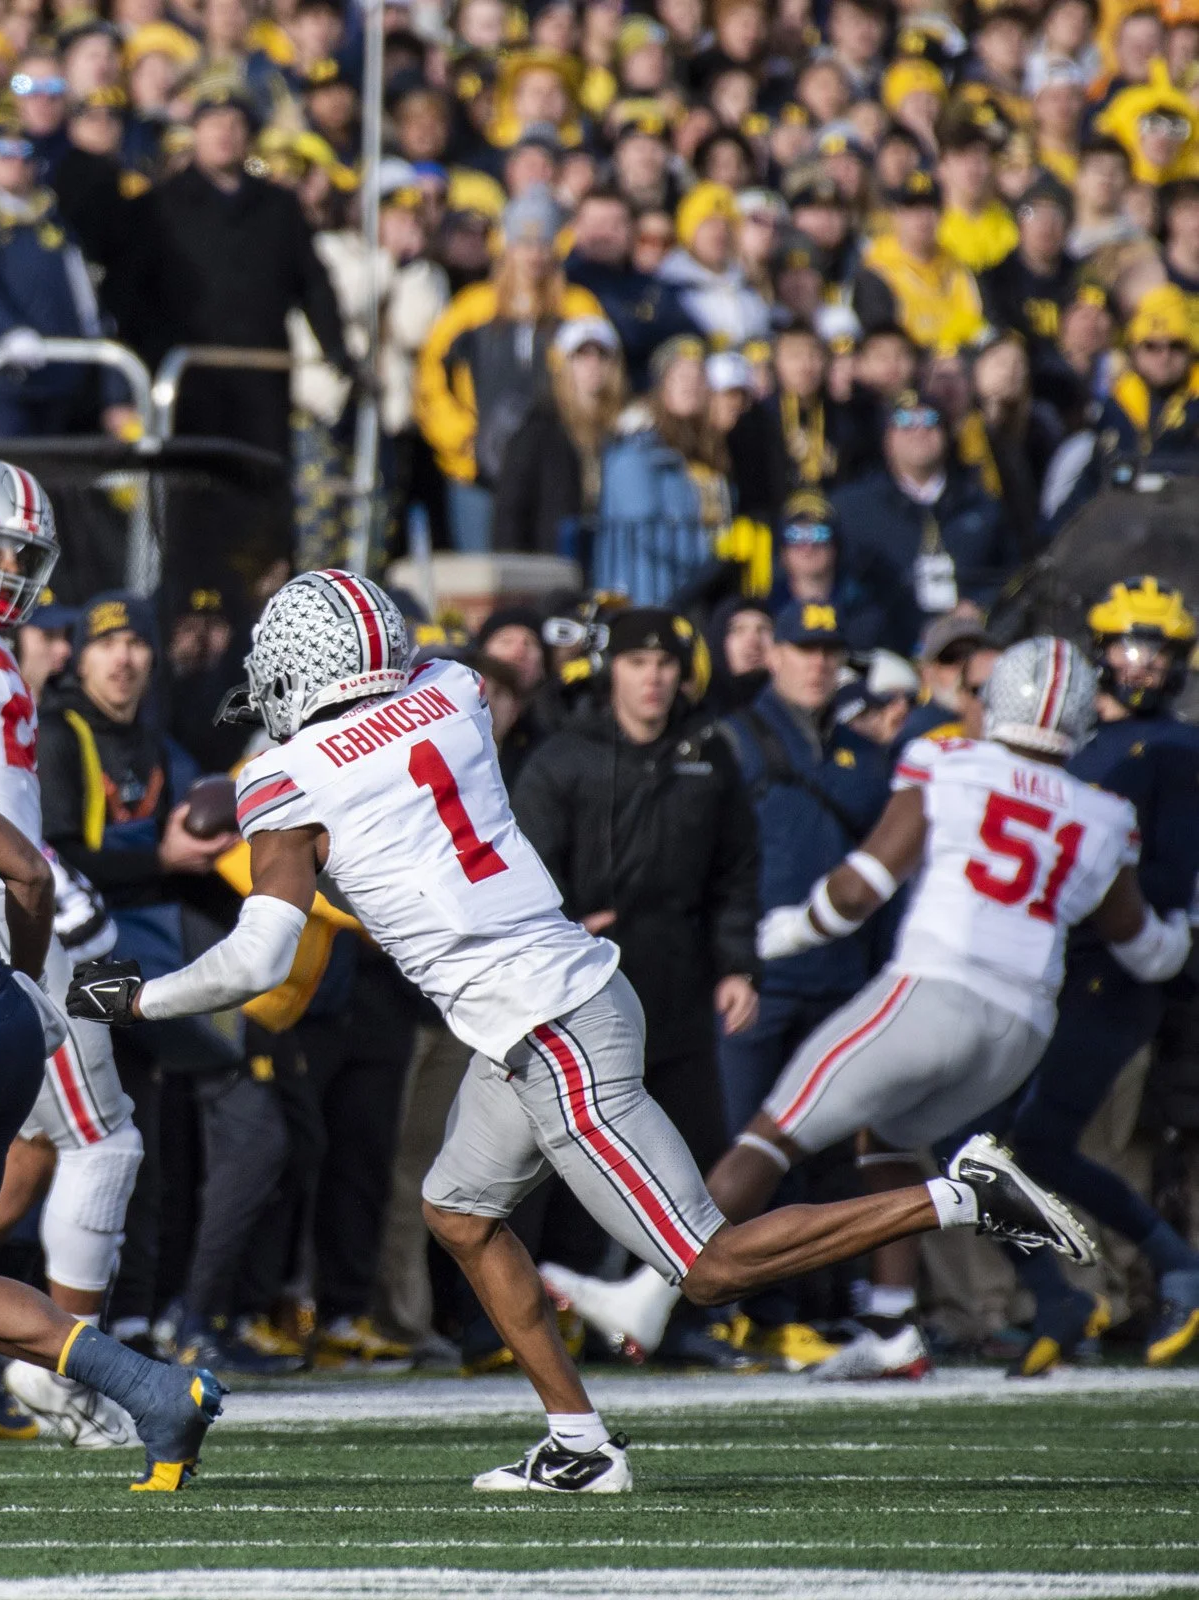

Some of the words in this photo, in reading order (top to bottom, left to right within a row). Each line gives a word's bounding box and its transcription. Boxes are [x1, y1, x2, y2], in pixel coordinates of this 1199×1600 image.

[340, 672, 405, 691] BUCKEYES
[316, 686, 459, 768] IGBINOSUN
[408, 738, 510, 884] 1
[1011, 767, 1067, 808] HALL
[964, 790, 1086, 924] 51
